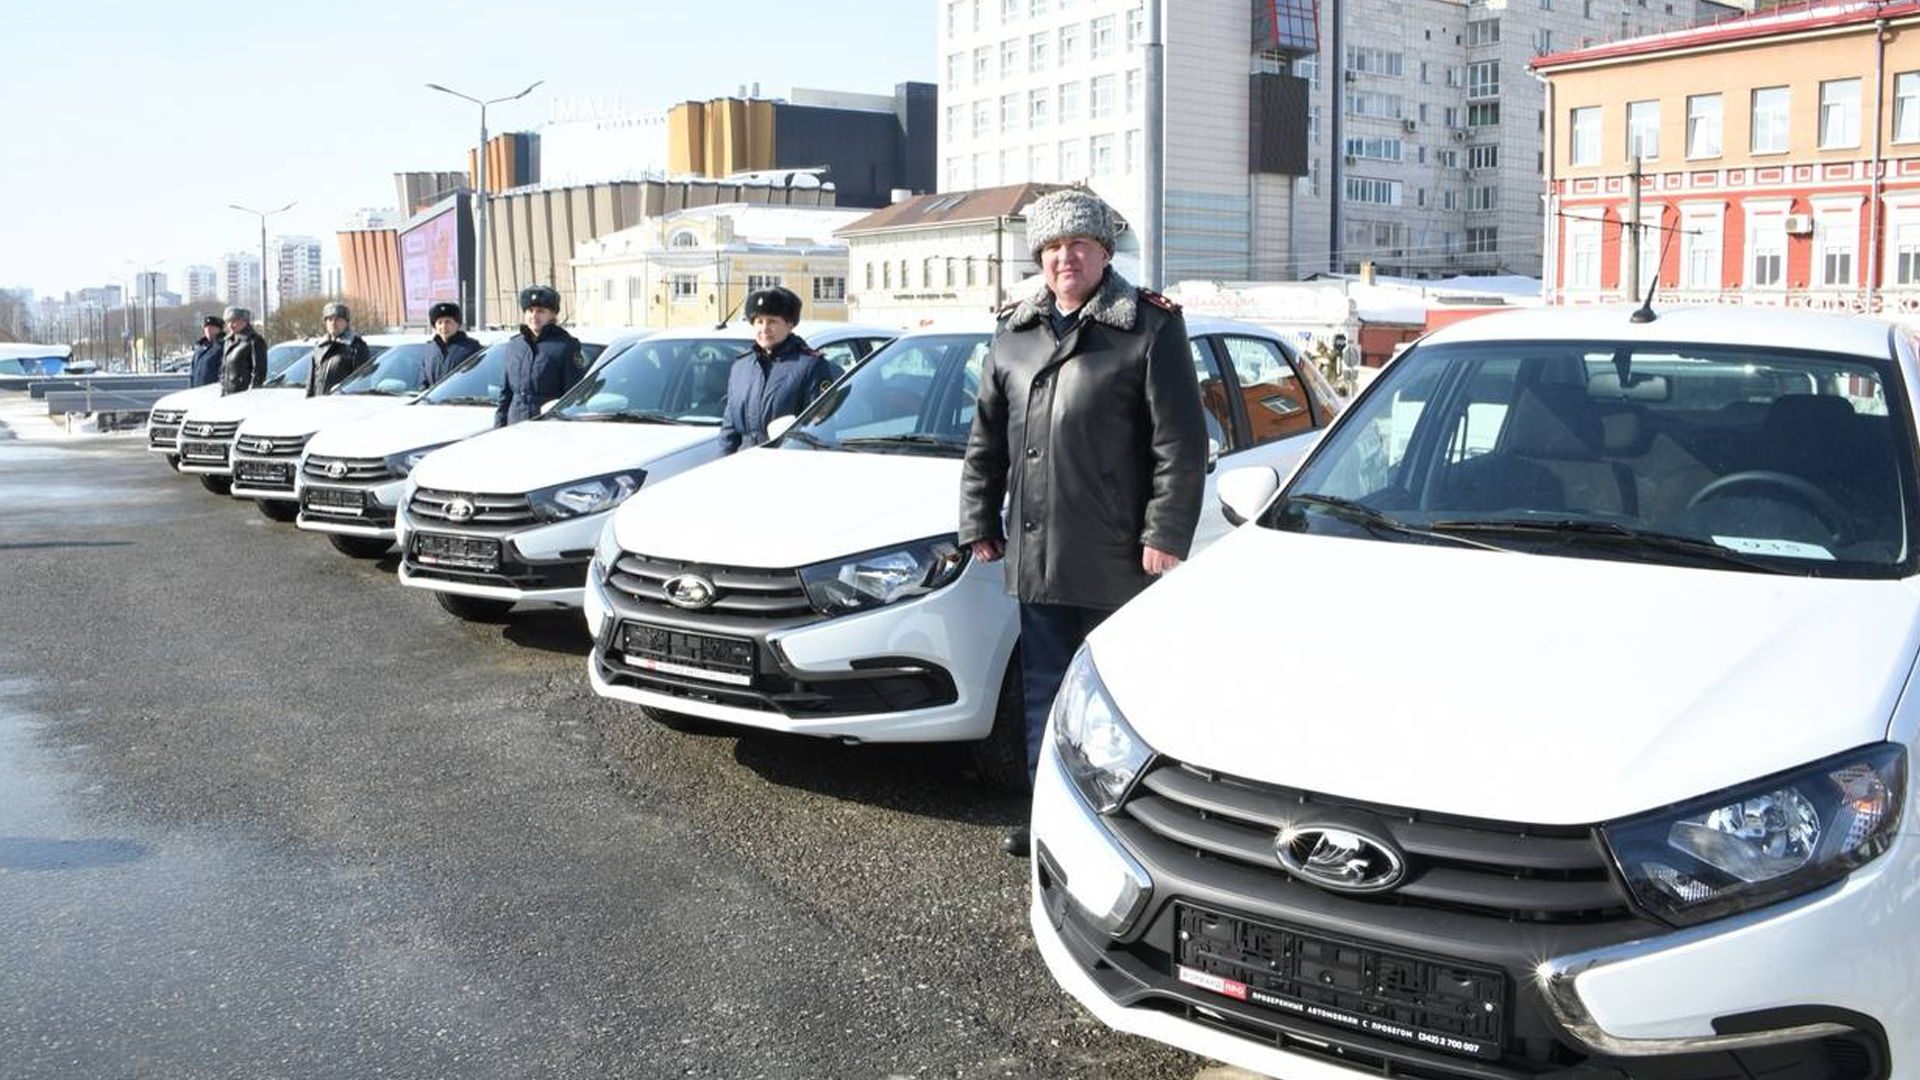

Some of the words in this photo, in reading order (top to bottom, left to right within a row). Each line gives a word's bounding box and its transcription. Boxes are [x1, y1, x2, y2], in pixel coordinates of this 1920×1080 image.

[1252, 992, 1304, 1012] ПРОВЕРЕННЫЕ
[1308, 1006, 1358, 1025] АВТОМОБИЛИ
[1362, 1020, 1368, 1028] С
[1371, 1022, 1413, 1039] ПРОБЕГОМ
[1418, 1031, 1439, 1046] (342)
[1440, 1037, 1446, 1046] 2
[1447, 1038, 1462, 1050] 700
[1463, 1042, 1480, 1054] 007
